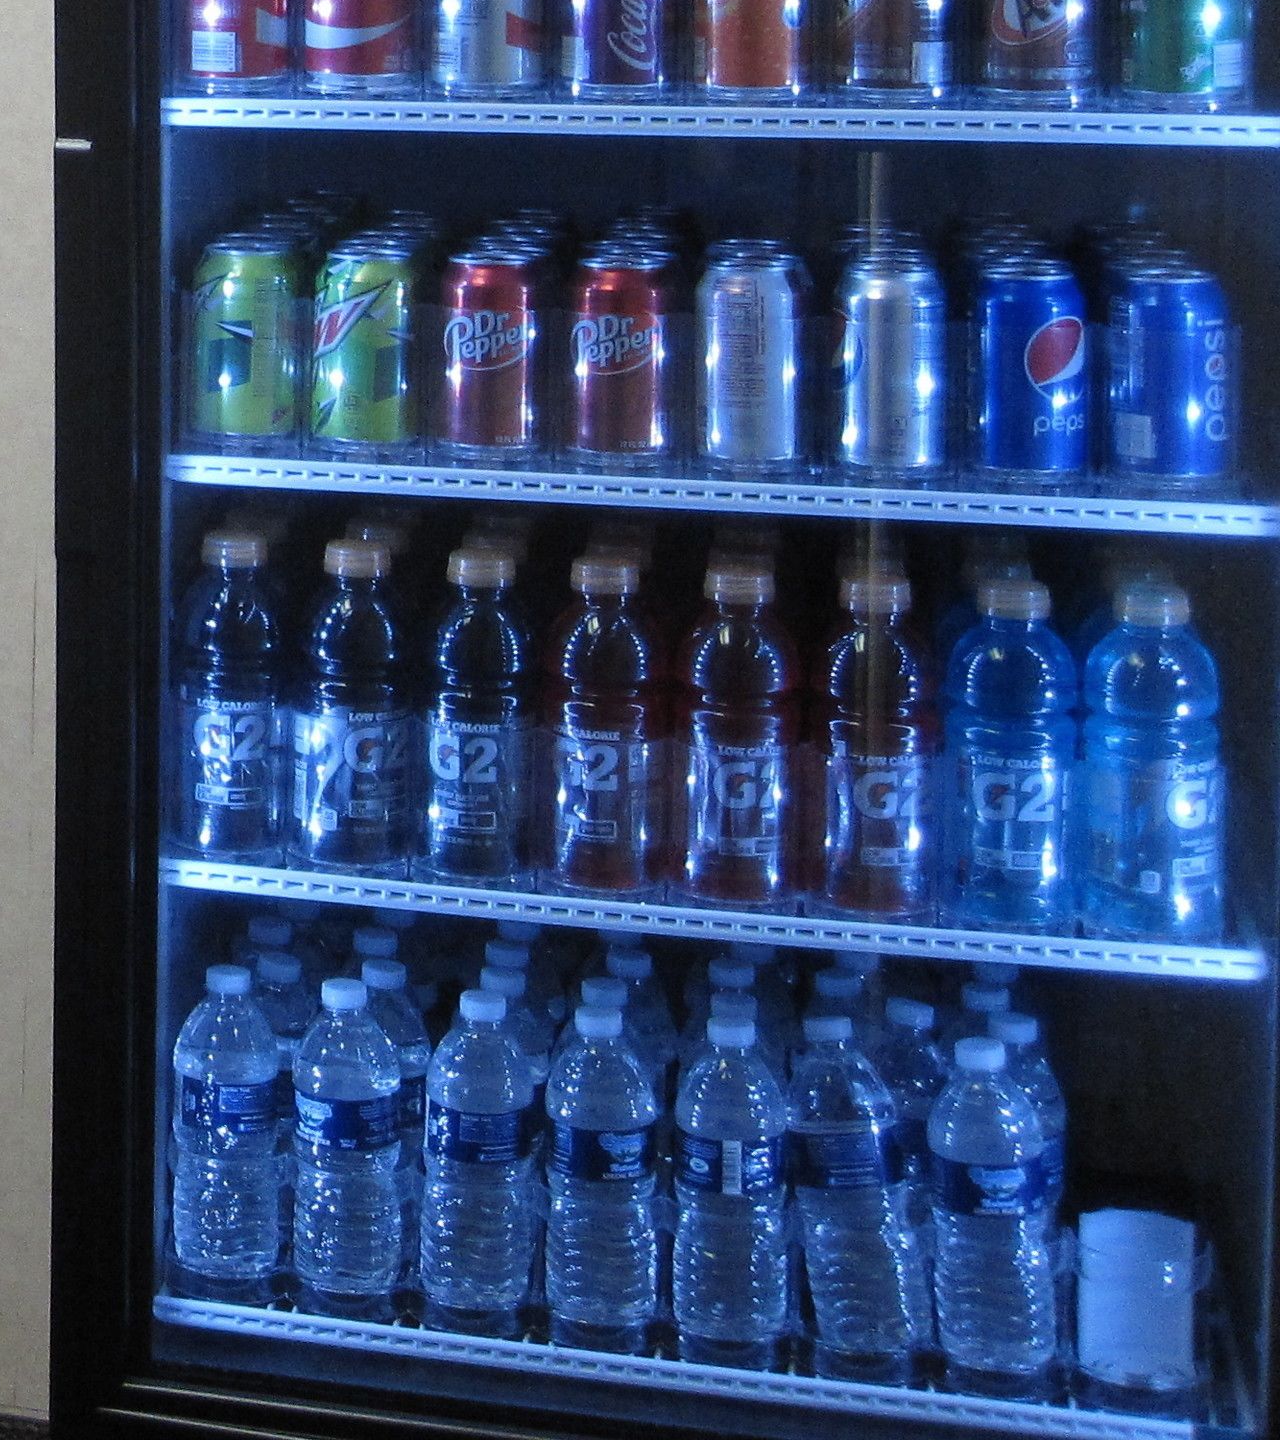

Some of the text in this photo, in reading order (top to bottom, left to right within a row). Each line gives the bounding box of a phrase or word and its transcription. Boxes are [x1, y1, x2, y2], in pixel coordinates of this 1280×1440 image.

[445, 310, 530, 363] Dr Pepper
[571, 314, 655, 368] Dr Pepper
[1196, 318, 1228, 442] pepsi
[1033, 413, 1085, 438] peps
[193, 712, 266, 761] G2
[429, 733, 498, 783] G2
[712, 760, 778, 810] G2
[852, 768, 918, 820] G2
[971, 771, 1056, 825] G2
